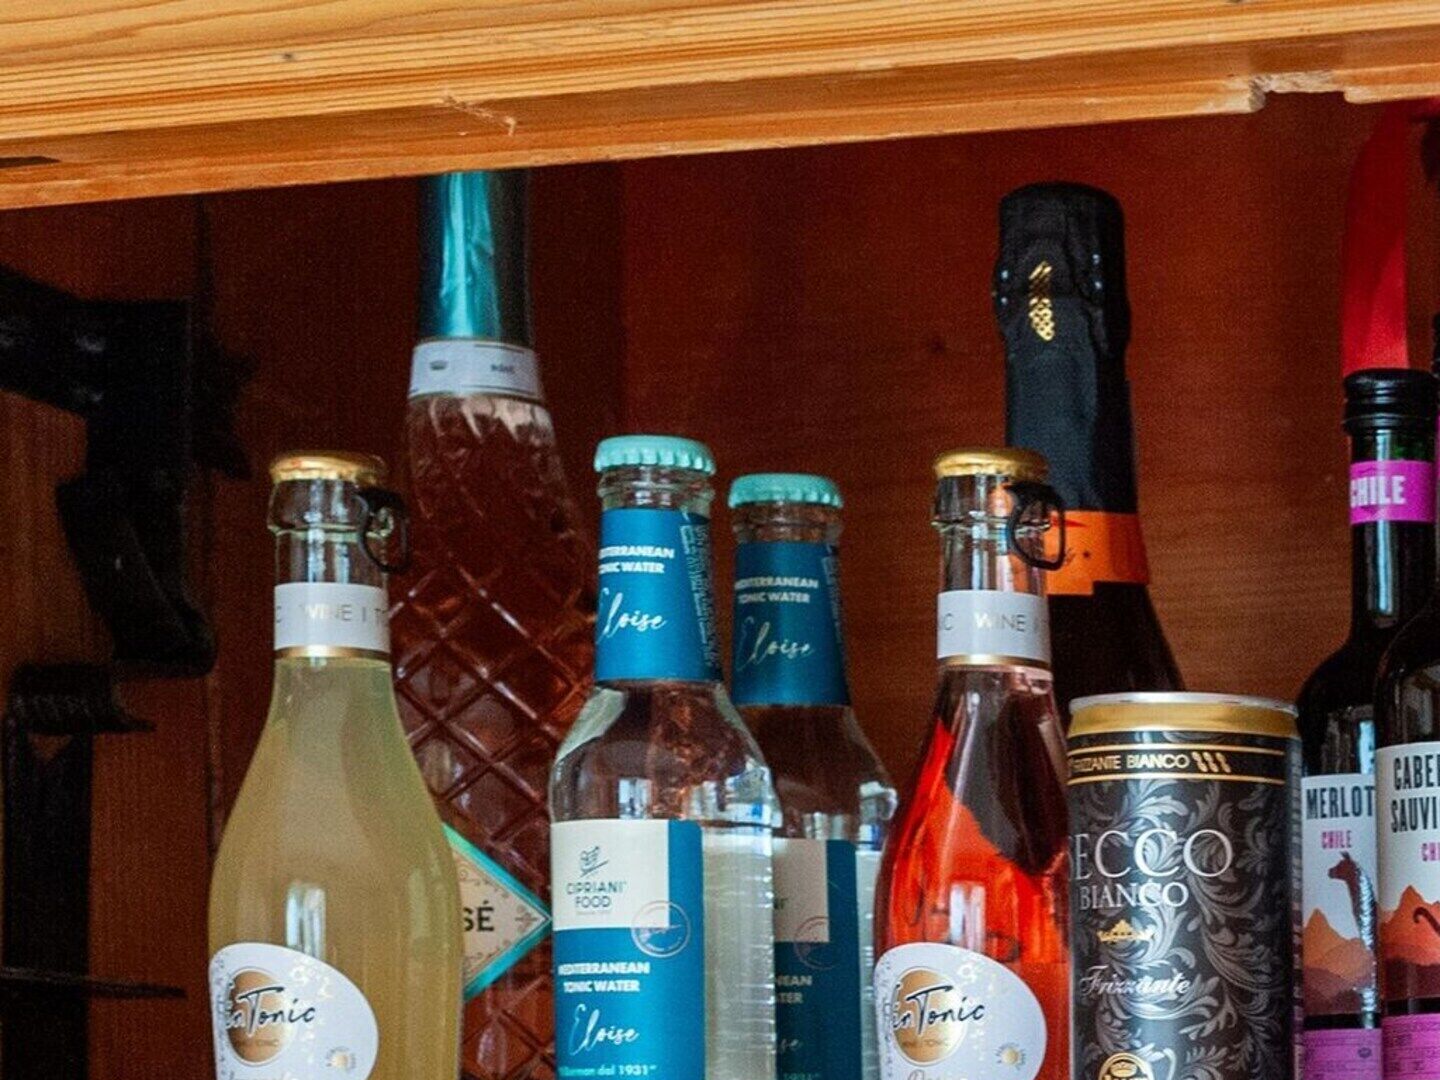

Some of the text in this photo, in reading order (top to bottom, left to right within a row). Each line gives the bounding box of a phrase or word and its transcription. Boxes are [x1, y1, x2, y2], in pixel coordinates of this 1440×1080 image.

[621, 562, 665, 574] WATER
[768, 591, 811, 604] WATER
[974, 612, 1025, 632] WINE
[1126, 754, 1190, 769] BIANCO
[1306, 785, 1375, 820] MERLOT
[1321, 830, 1353, 849] CHILE
[1073, 829, 1233, 881] ECCO
[575, 895, 611, 908] FOOD
[1080, 881, 1189, 911] BIANCO
[593, 980, 640, 992] WATER
[569, 1003, 639, 1056] Eloise
